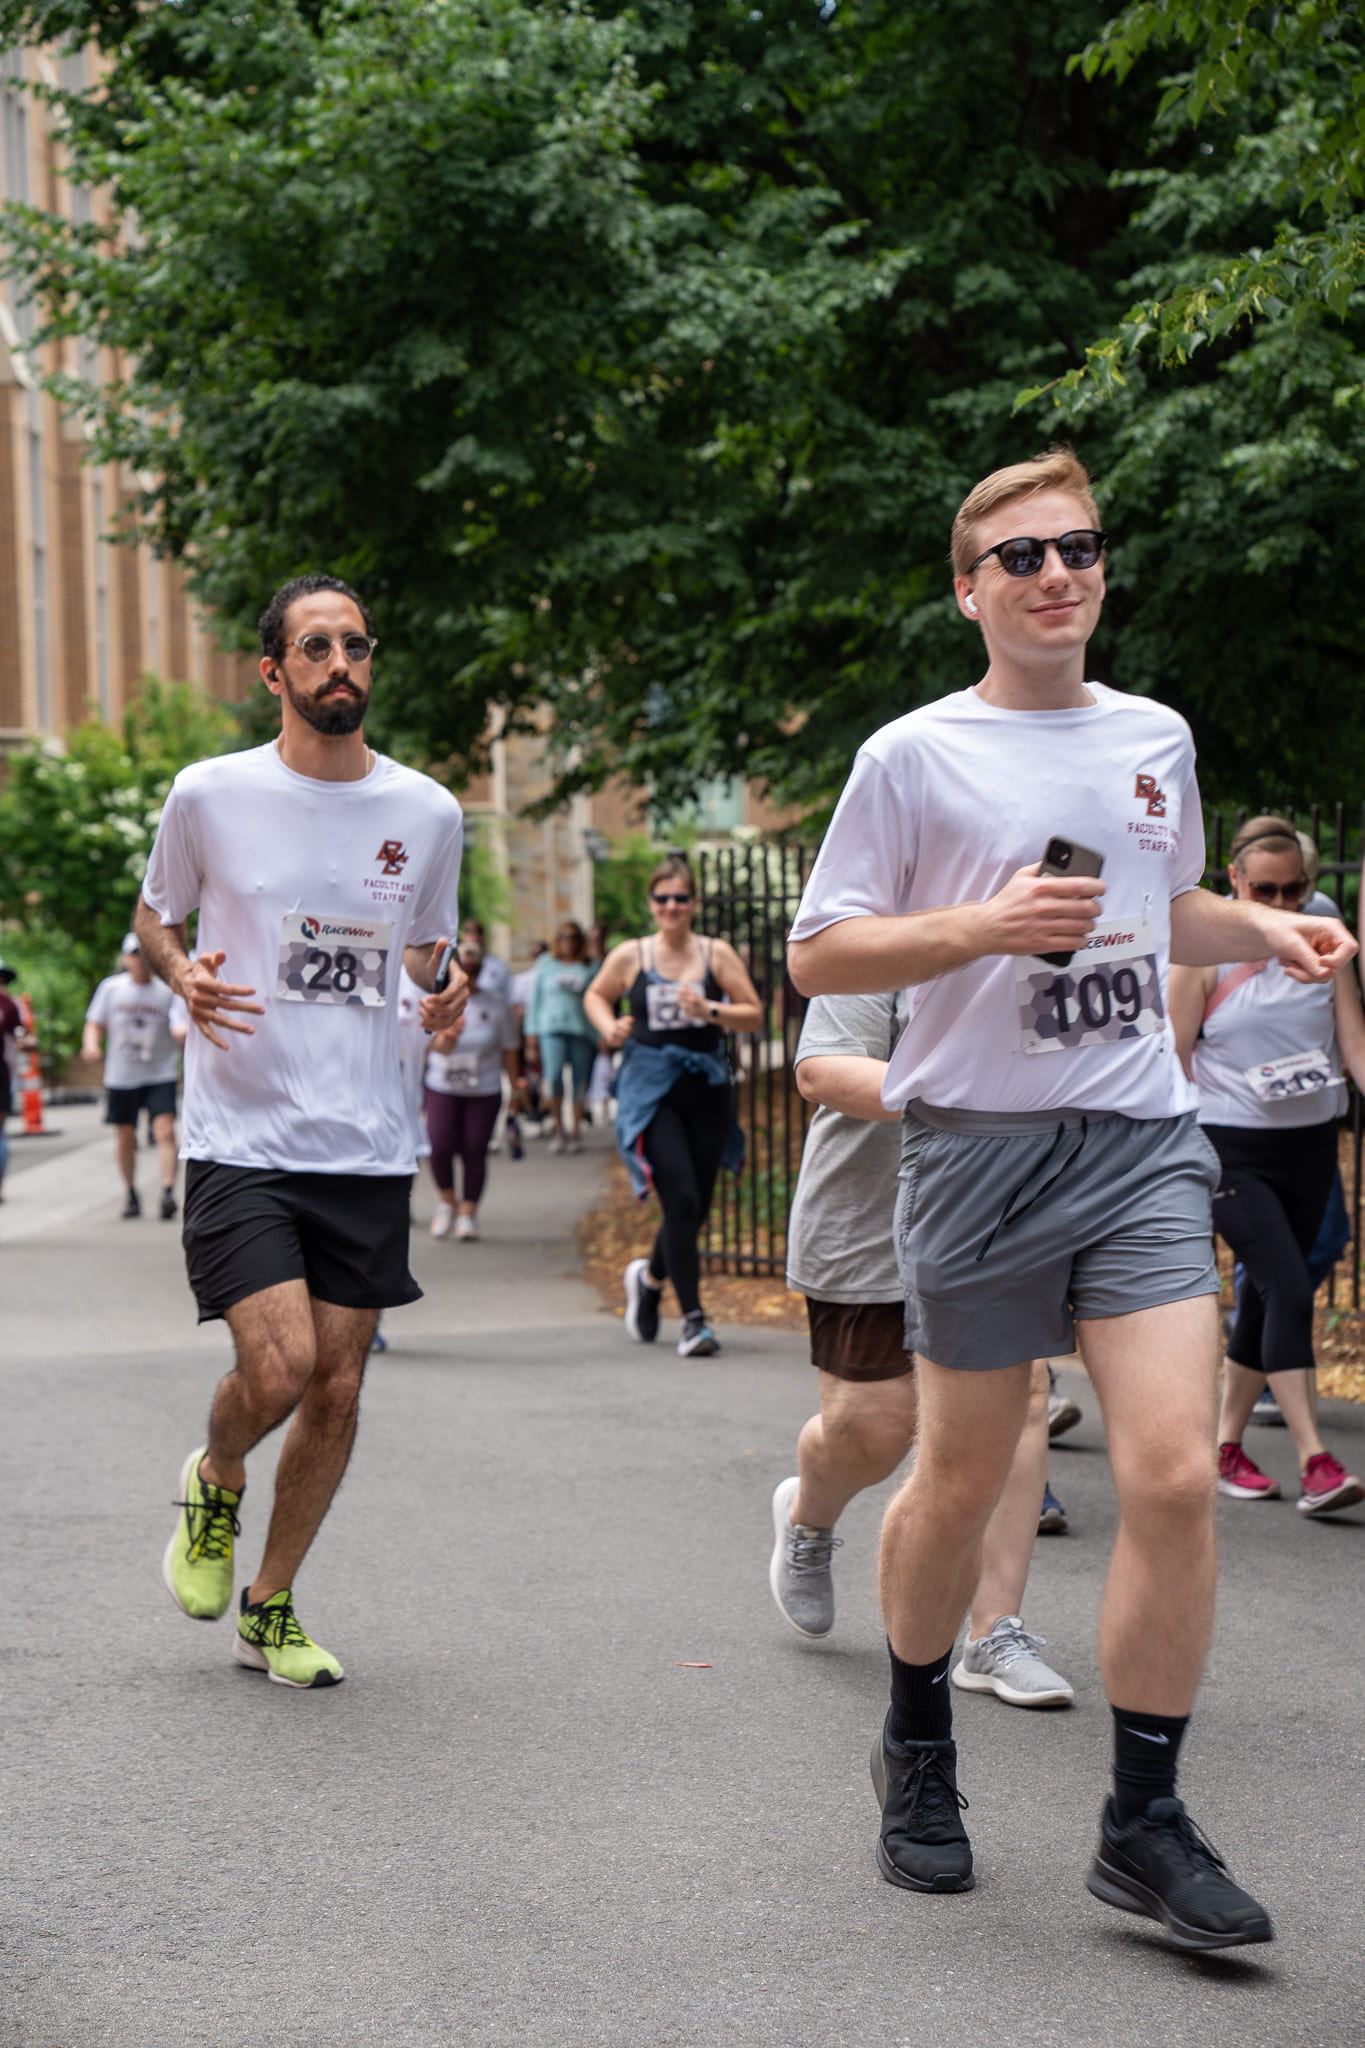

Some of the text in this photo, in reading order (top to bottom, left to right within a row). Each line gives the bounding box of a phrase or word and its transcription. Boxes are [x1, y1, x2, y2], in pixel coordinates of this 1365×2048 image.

[1138, 839, 1168, 853] STAFF
[363, 879, 400, 890] FACULTY
[1087, 932, 1135, 950] ceWire
[307, 950, 357, 993] 28
[1044, 967, 1142, 1033] 109
